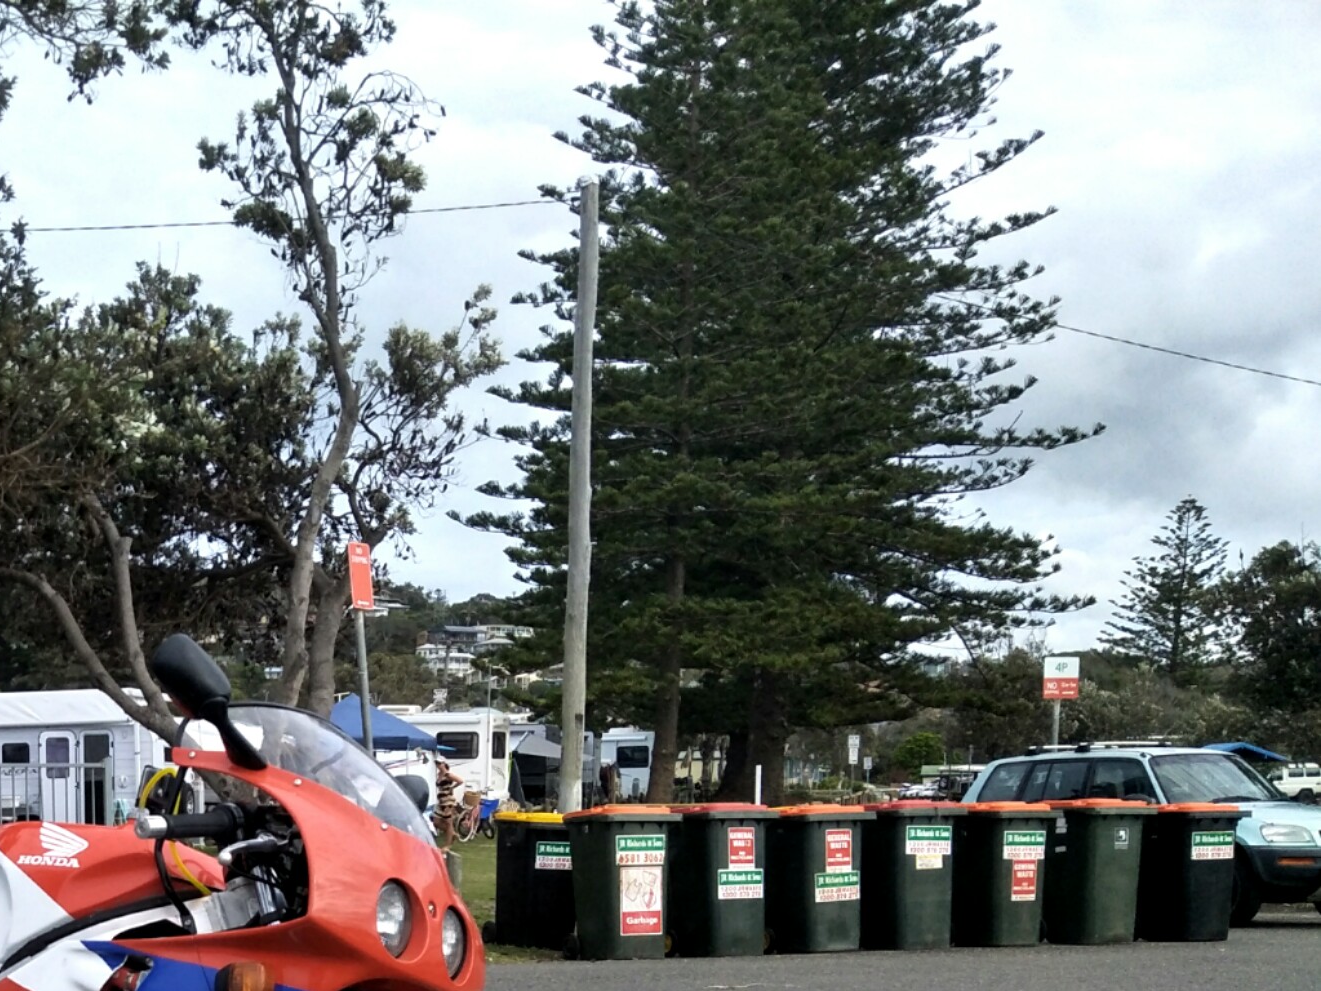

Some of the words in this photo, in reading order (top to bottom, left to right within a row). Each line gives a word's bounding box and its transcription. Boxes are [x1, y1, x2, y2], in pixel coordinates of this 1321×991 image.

[1054, 662, 1068, 672] 4P
[1046, 681, 1058, 690] NO
[17, 855, 80, 868] HONDA
[626, 916, 658, 925] Garbage
